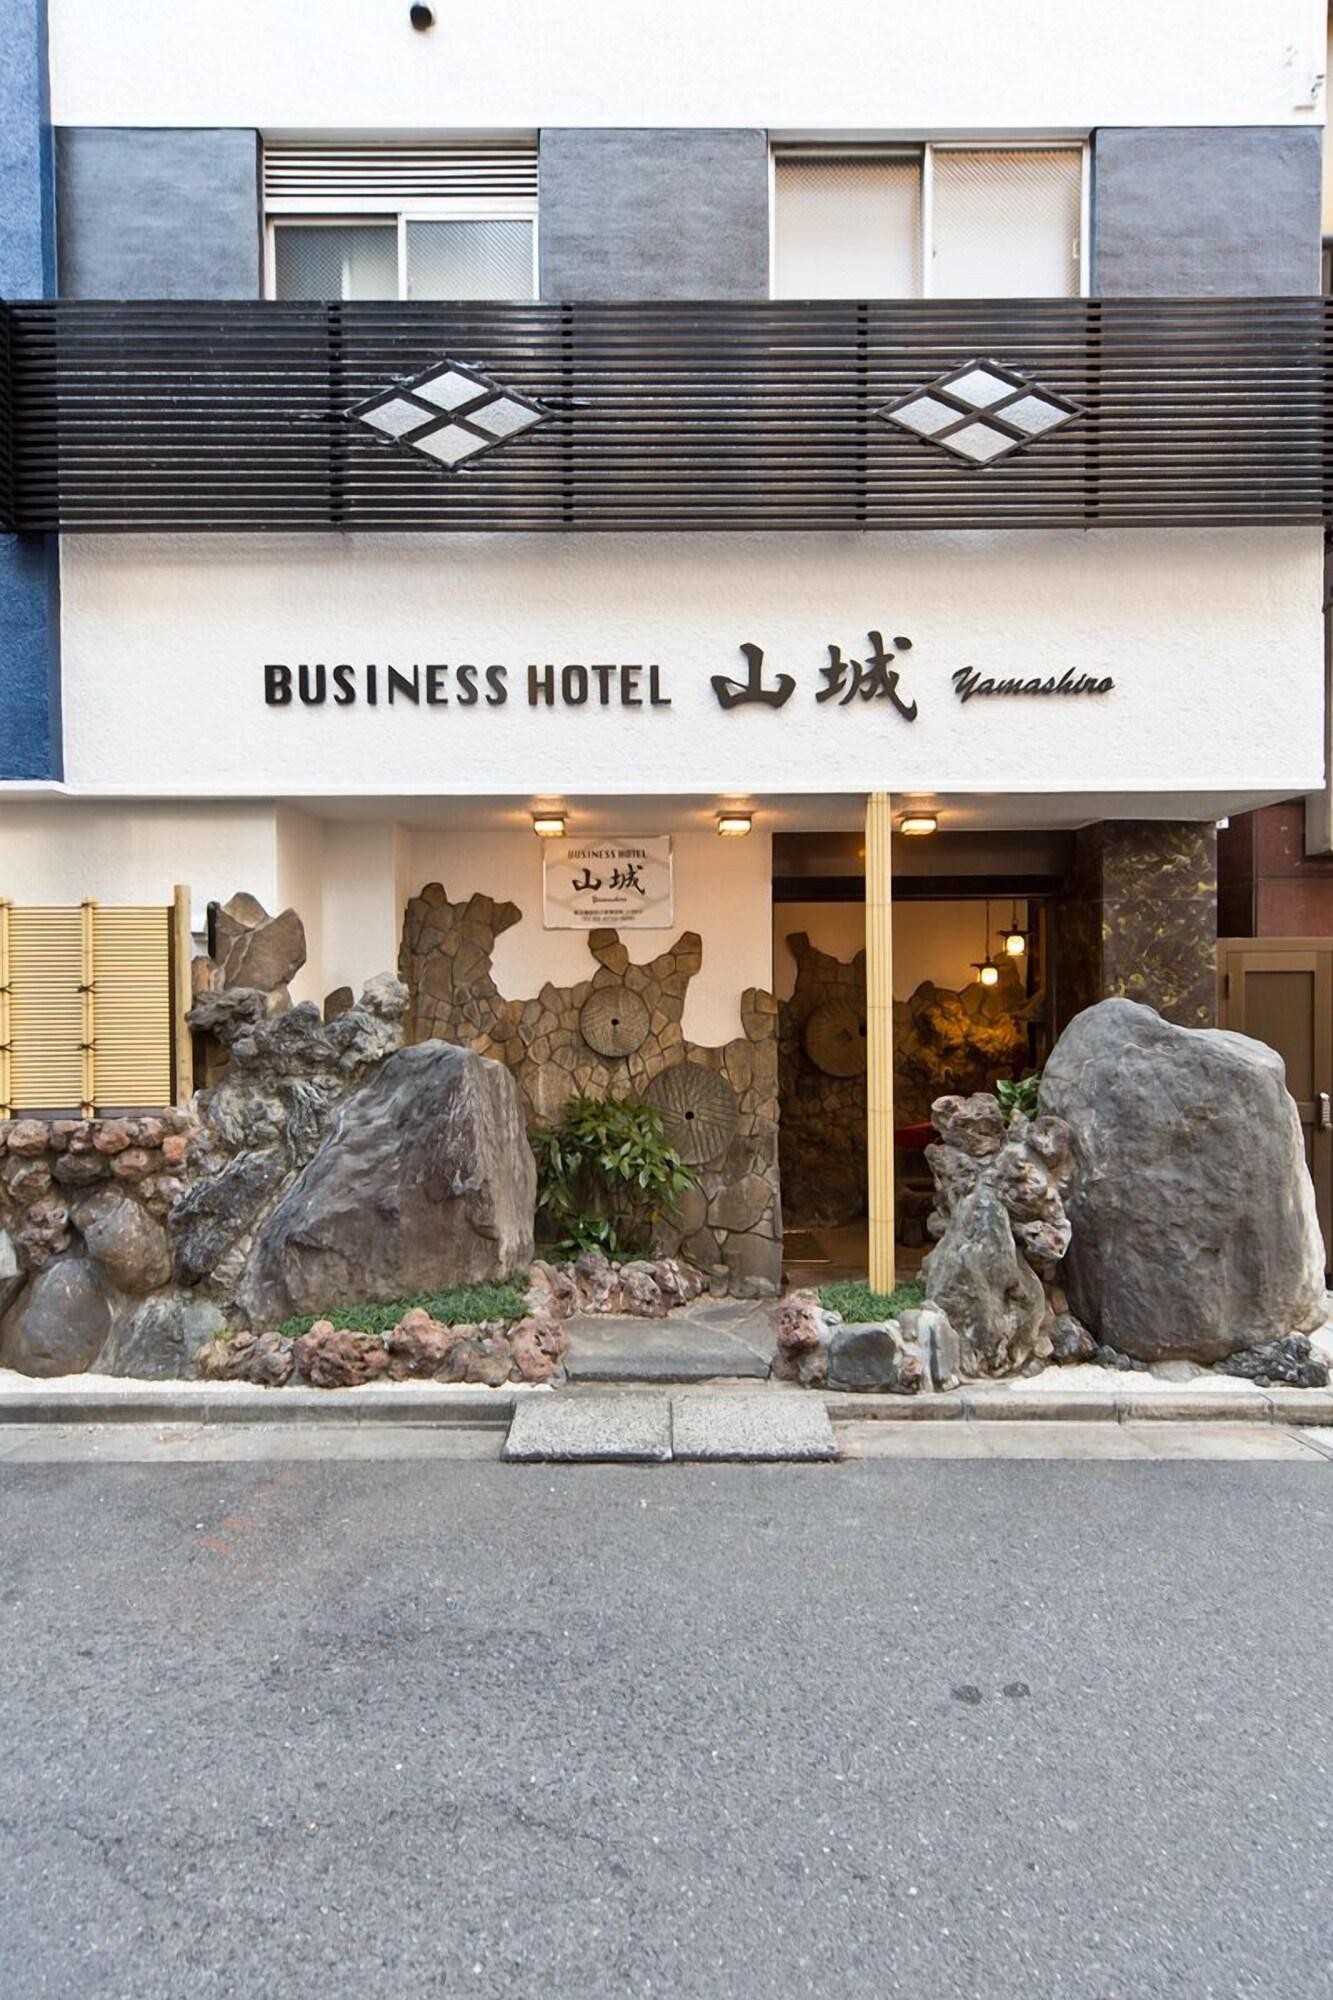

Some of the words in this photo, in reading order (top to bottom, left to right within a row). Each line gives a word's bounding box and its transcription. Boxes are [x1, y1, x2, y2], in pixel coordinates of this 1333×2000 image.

[264, 664, 508, 707] BUSINESS
[527, 664, 672, 707] HOTEL
[710, 630, 918, 723] 山城
[951, 666, 1115, 704] Yamashiro
[567, 850, 616, 859] BUSINESS
[618, 849, 646, 859] HOTEL
[572, 863, 645, 895] 山城
